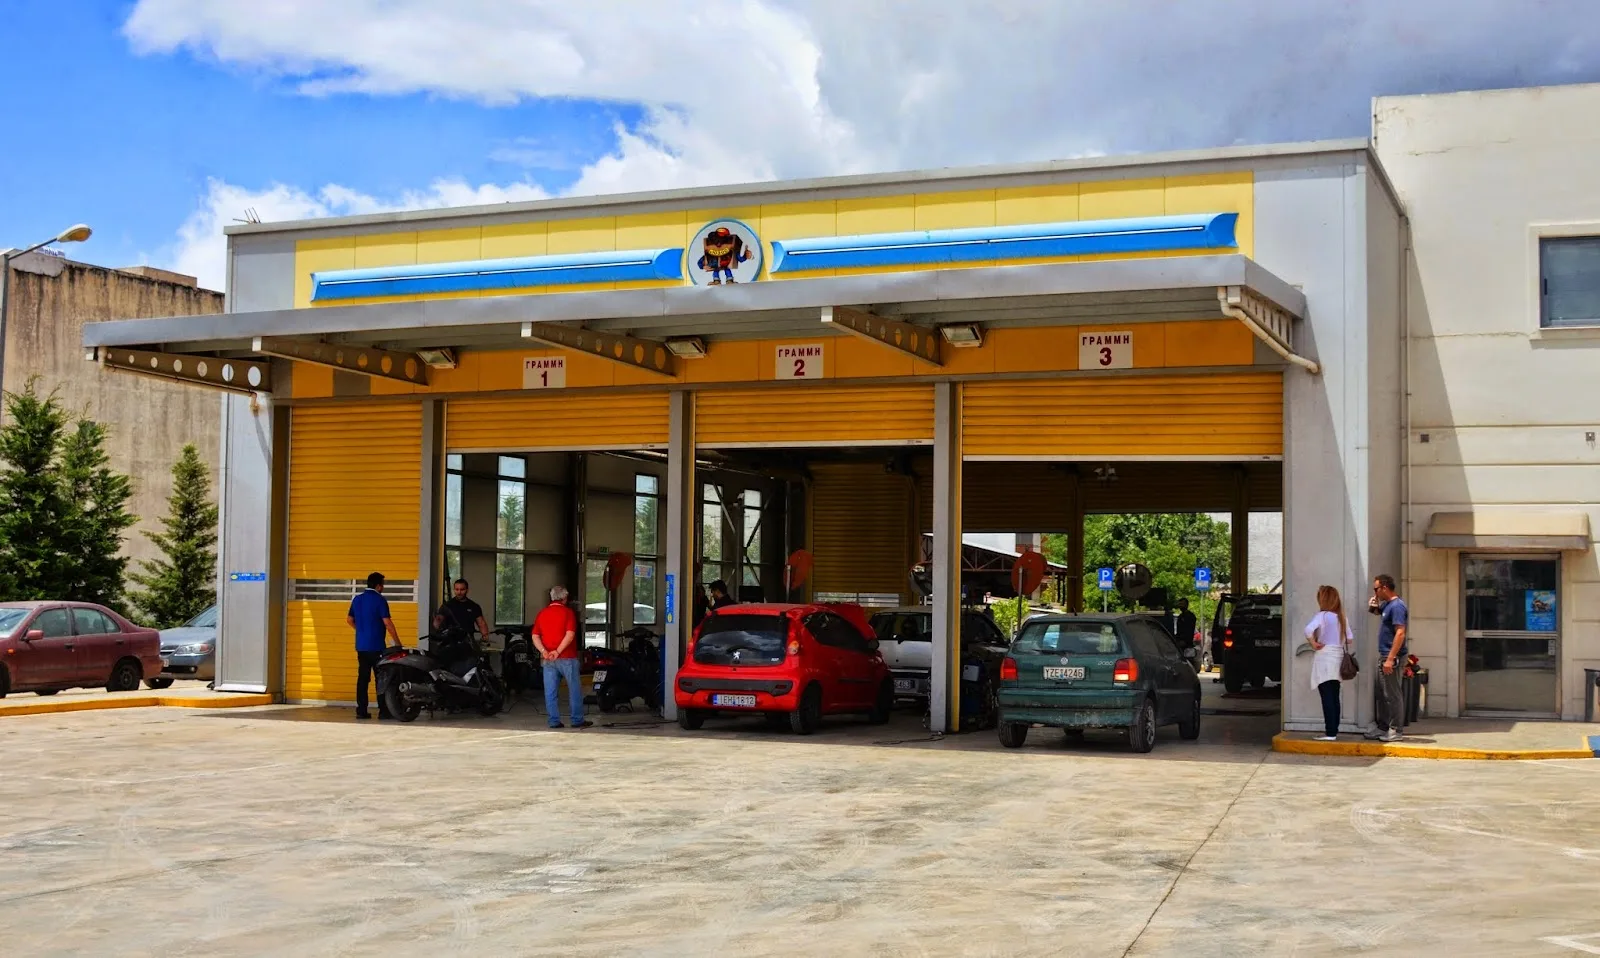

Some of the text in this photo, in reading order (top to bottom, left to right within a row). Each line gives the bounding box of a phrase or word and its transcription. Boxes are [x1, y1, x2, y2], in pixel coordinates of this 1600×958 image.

[1082, 334, 1130, 346] ΓΡΑΜΜΗ
[778, 347, 821, 358] ΓΡΑΜΜΗ
[1099, 347, 1112, 366] 3
[525, 359, 563, 369] ΓΡΑΜΜΗ
[793, 359, 805, 377] 2
[541, 370, 547, 387] 1
[1101, 569, 1110, 581] P
[1198, 569, 1207, 581] P
